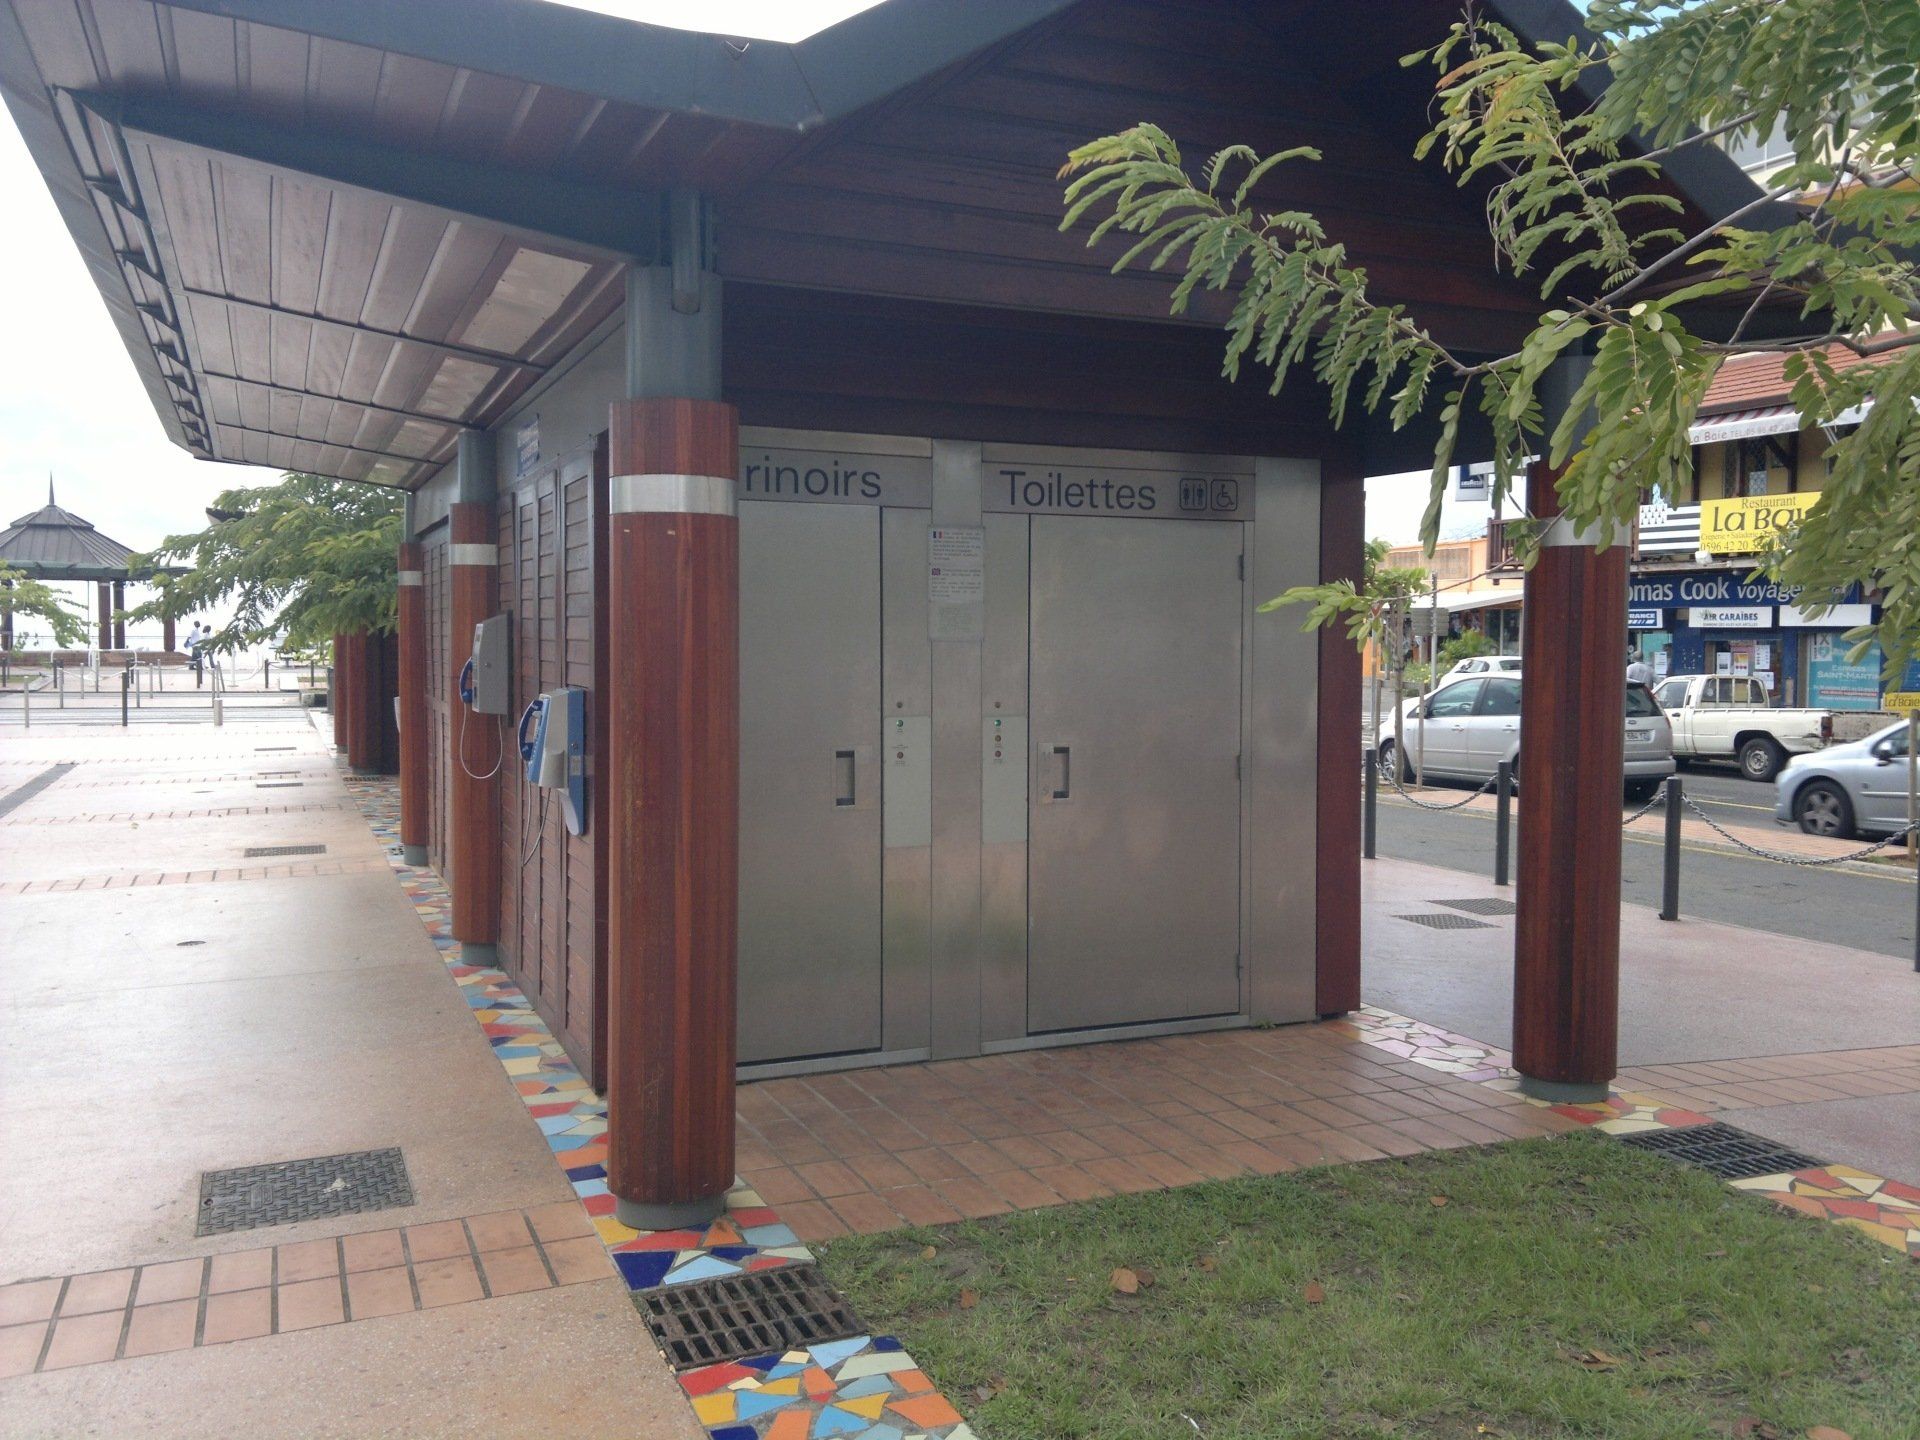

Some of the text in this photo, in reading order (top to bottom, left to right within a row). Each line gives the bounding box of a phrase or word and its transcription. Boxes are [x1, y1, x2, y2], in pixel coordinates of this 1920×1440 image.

[745, 455, 882, 498] rinoirs
[999, 469, 1157, 511] Toilettes
[1741, 496, 1797, 509] Restaurant
[1713, 506, 1745, 532] La
[1700, 542, 1722, 552] 0596
[1724, 541, 1736, 551] 42
[1738, 540, 1749, 551] 20
[1680, 576, 1730, 601] Cook
[1704, 610, 1759, 622] AIR CARAÏBES
